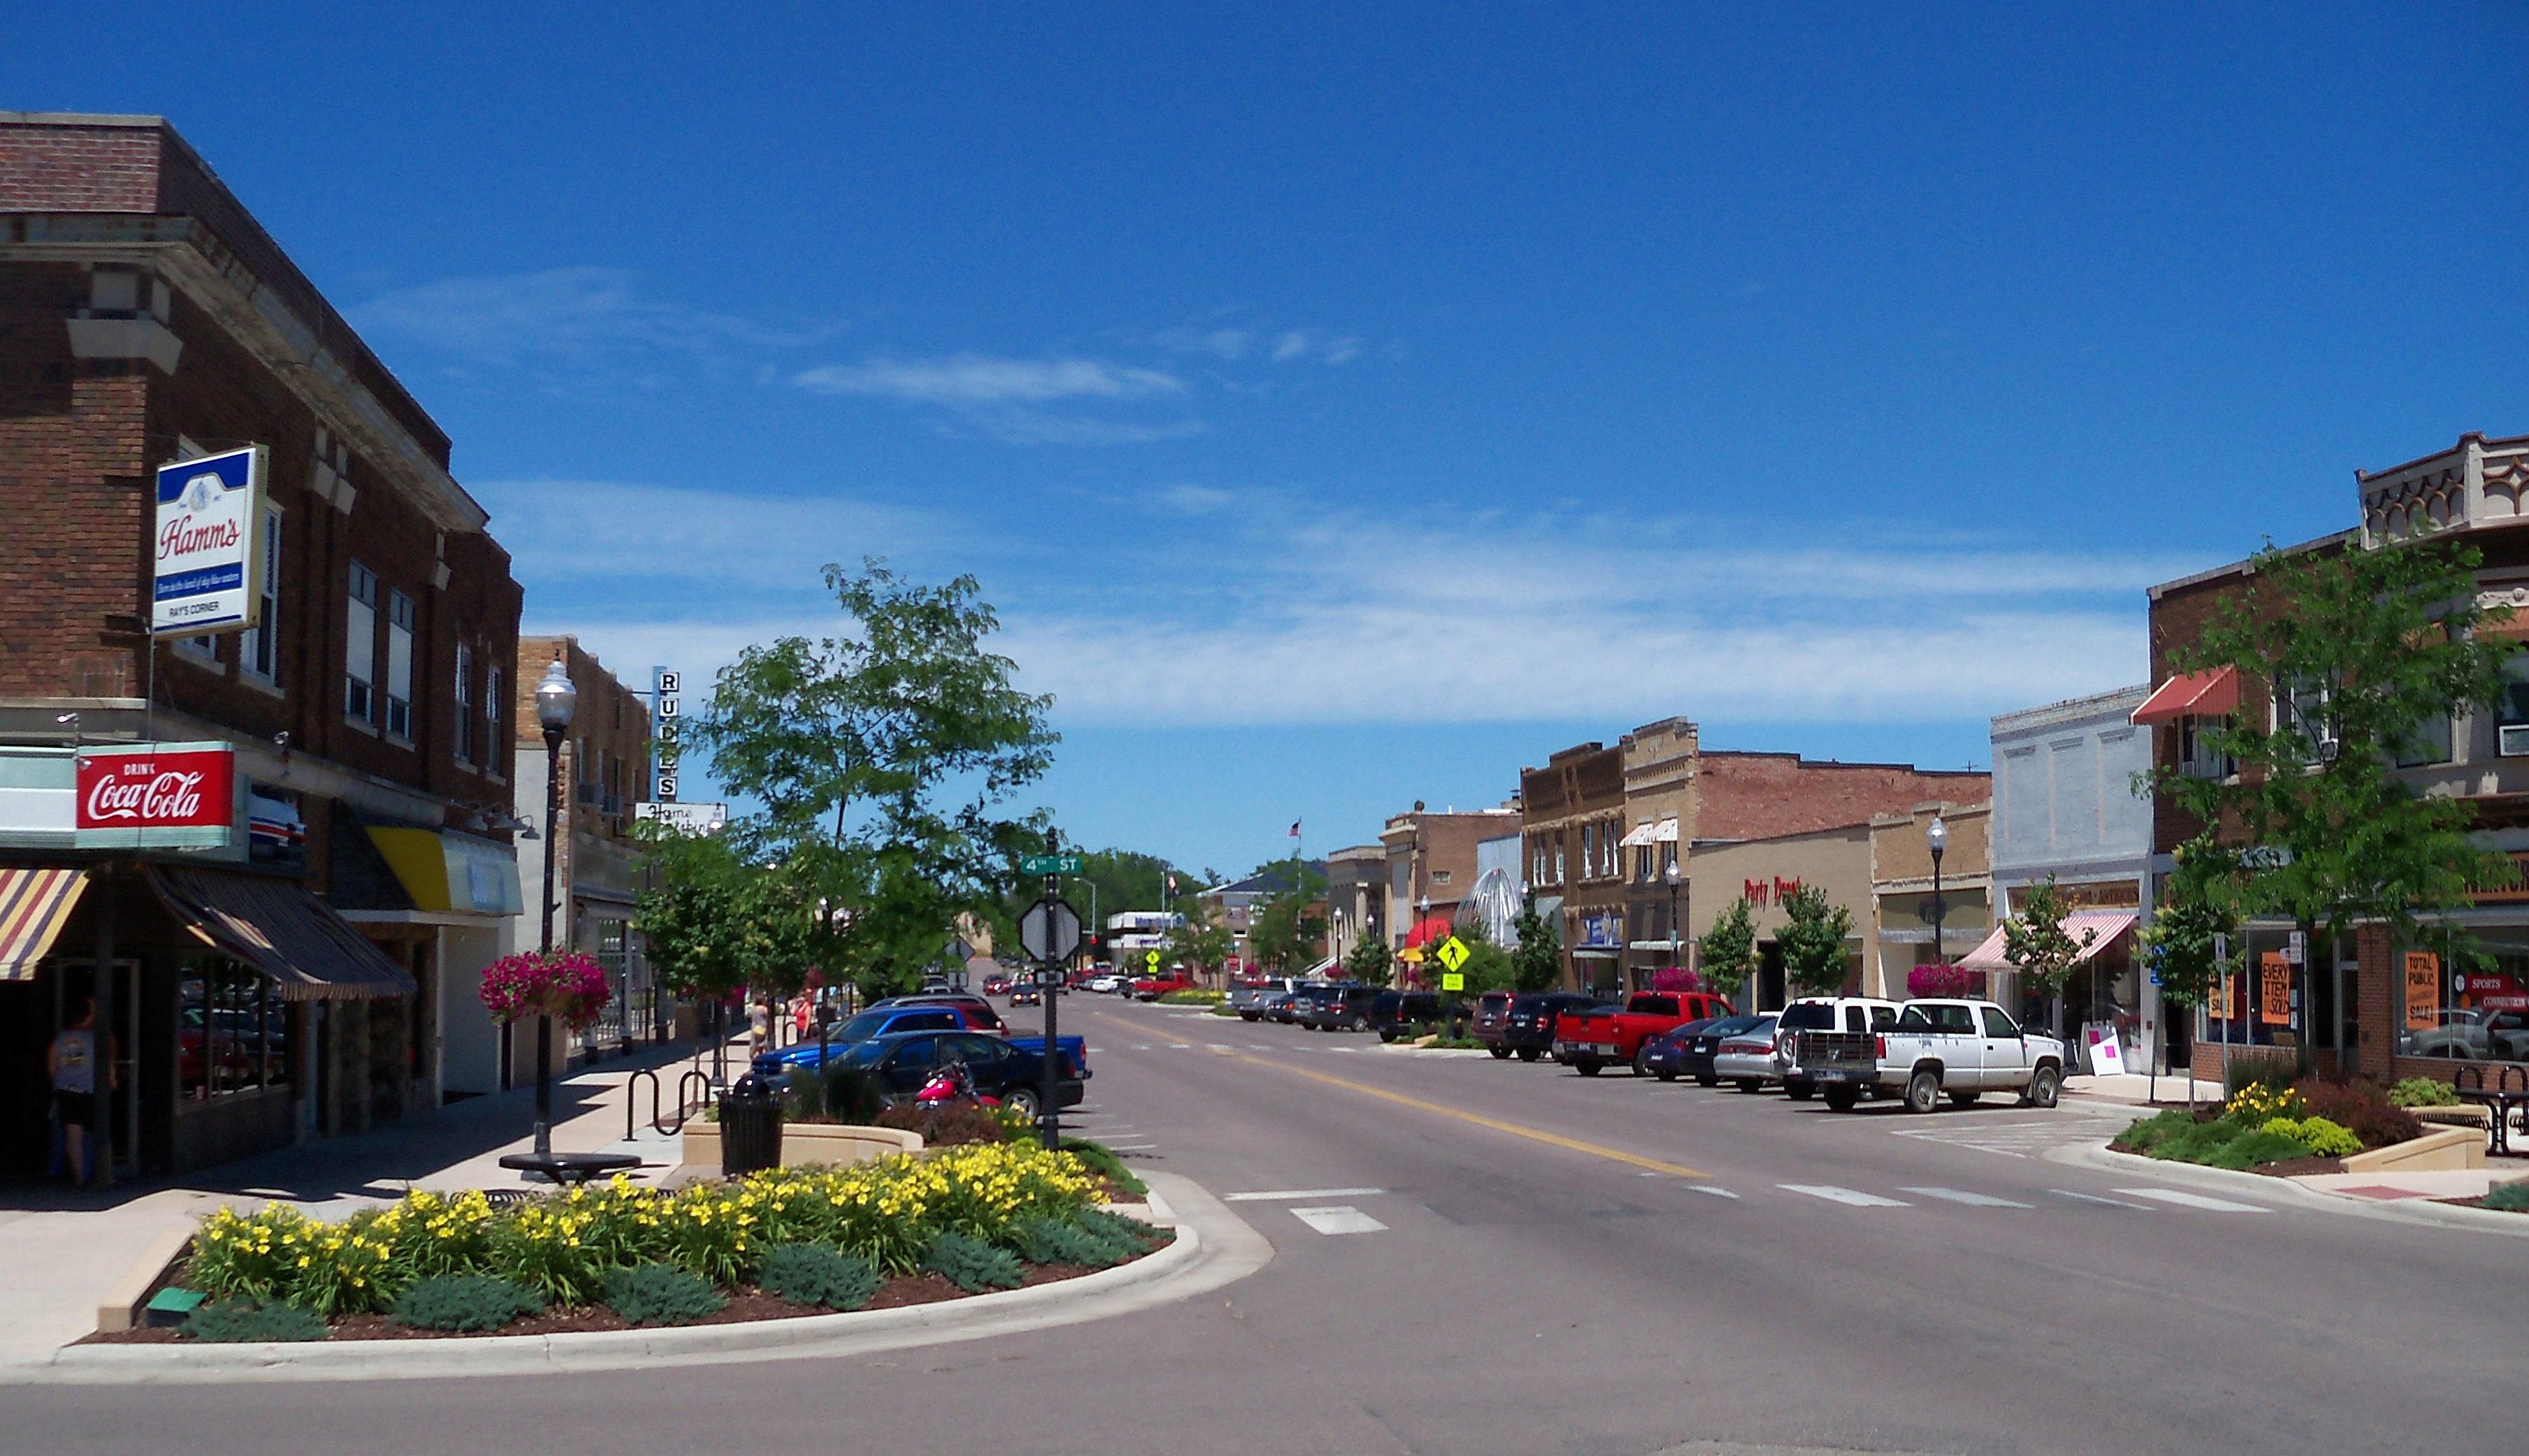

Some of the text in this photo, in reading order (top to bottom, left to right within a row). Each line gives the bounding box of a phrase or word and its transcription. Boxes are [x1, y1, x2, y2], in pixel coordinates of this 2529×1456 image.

[158, 514, 240, 560] Hamm's
[169, 601, 219, 616] RAY'S CORNER
[124, 763, 155, 776] DRINK
[1059, 859, 1077, 871] ST
[2409, 955, 2433, 970] TOTAL
[2263, 963, 2287, 980] EVERY
[2408, 972, 2435, 986] PUBLIC
[2265, 981, 2287, 996] ITEM
[2472, 979, 2501, 989] SPORTS
[2270, 998, 2290, 1014] SOLD
[2483, 996, 2526, 1007] CONNECTION
